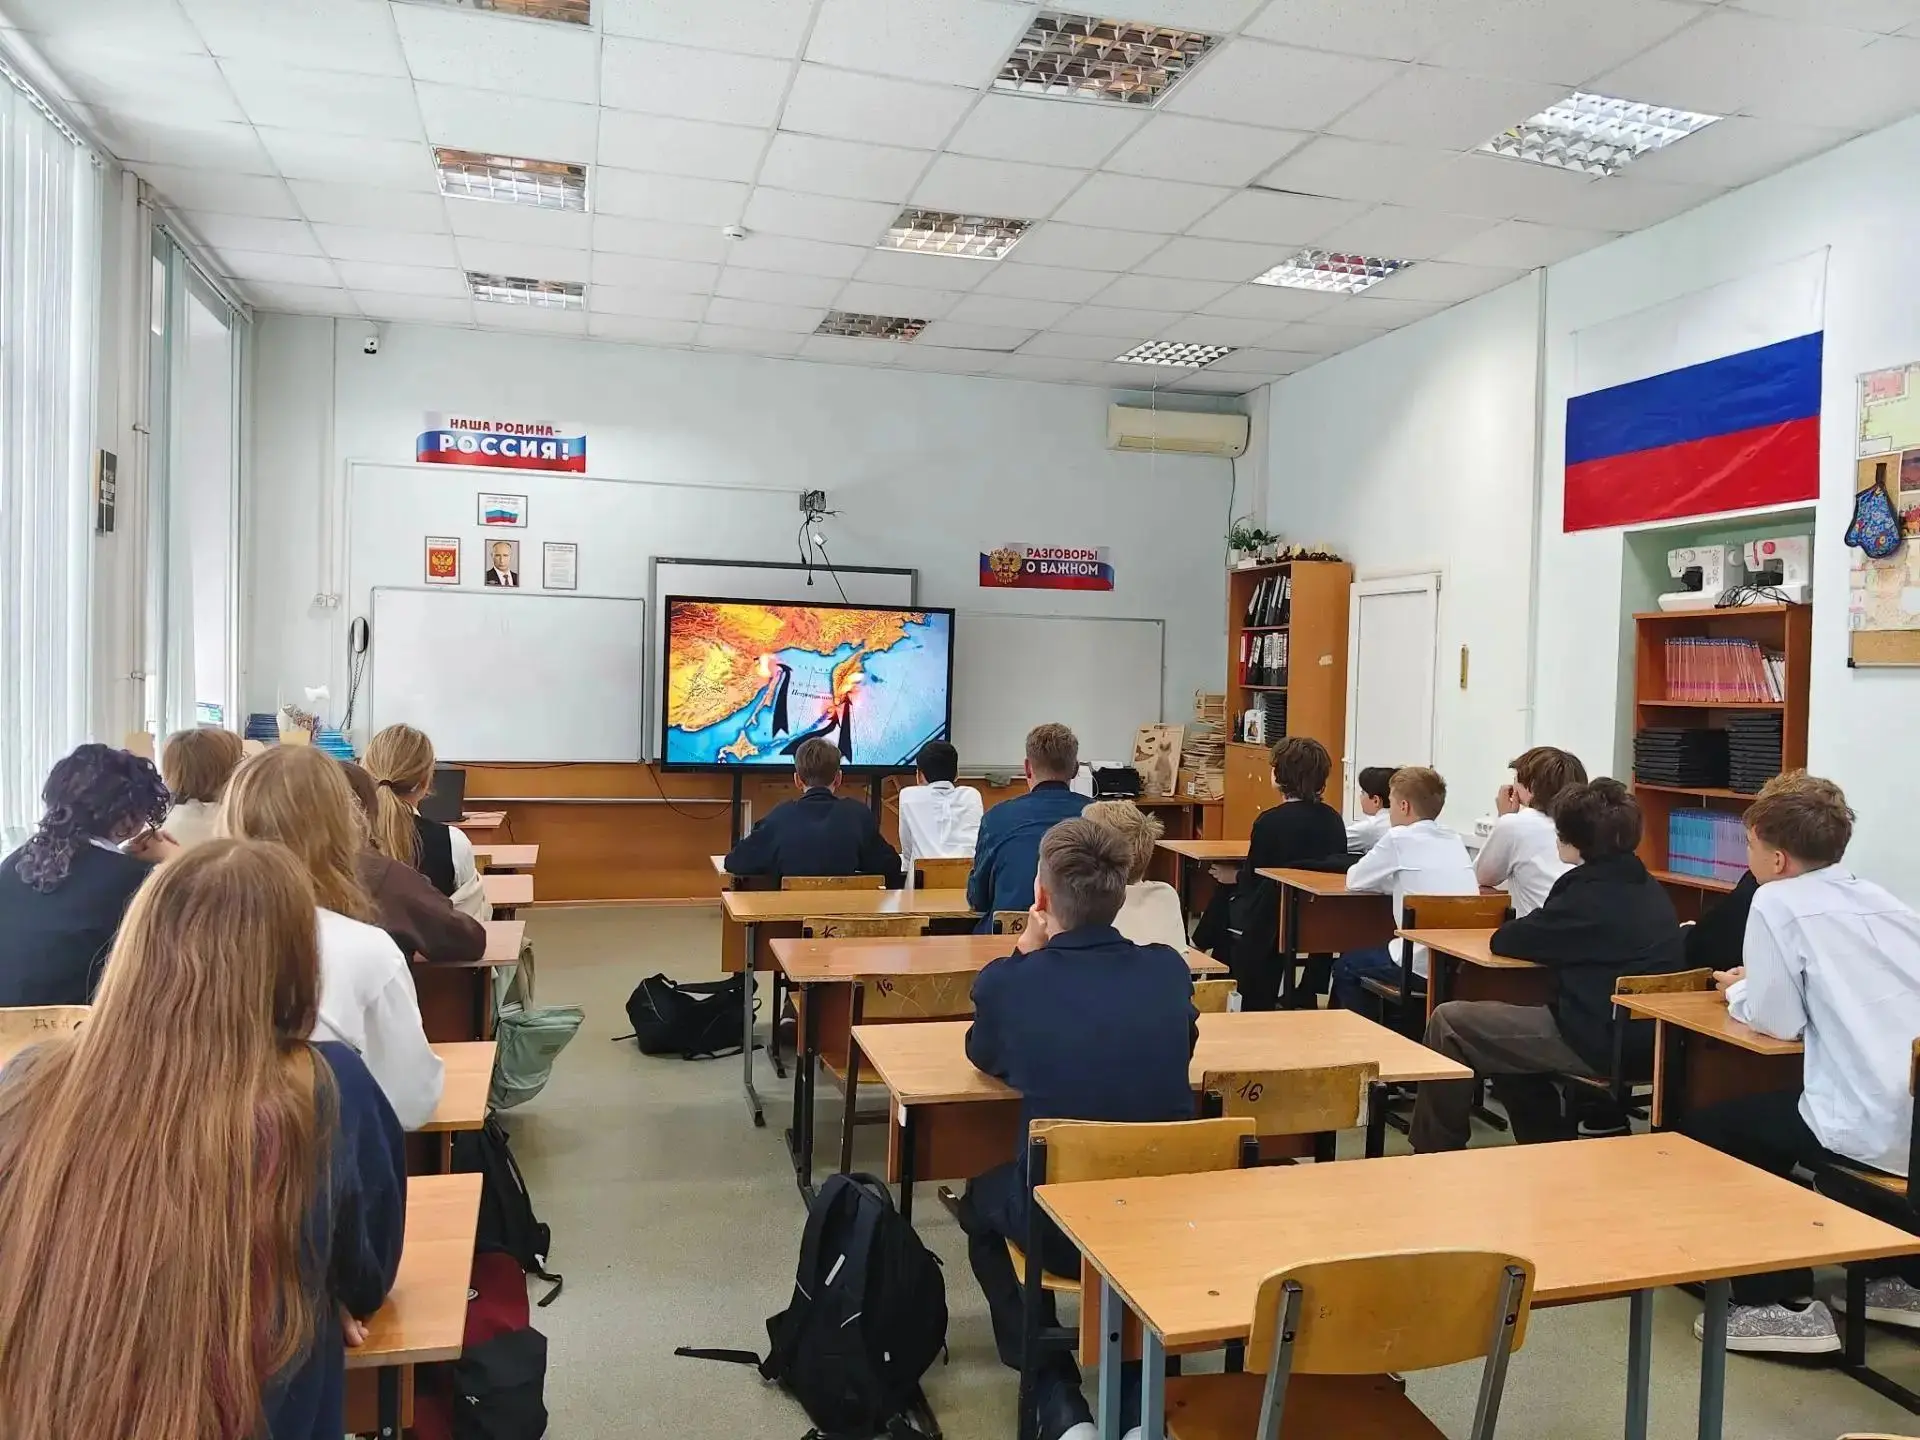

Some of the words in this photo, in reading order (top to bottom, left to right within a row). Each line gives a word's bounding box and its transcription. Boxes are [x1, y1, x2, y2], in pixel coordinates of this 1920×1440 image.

[450, 418, 491, 431] НАША
[439, 434, 570, 461] РОССИЯ!
[1026, 547, 1098, 560] РАЗГОВОРЫ
[1026, 562, 1036, 573] О
[1040, 562, 1099, 575] ВАЖНОМ
[1236, 1080, 1264, 1102] 16
